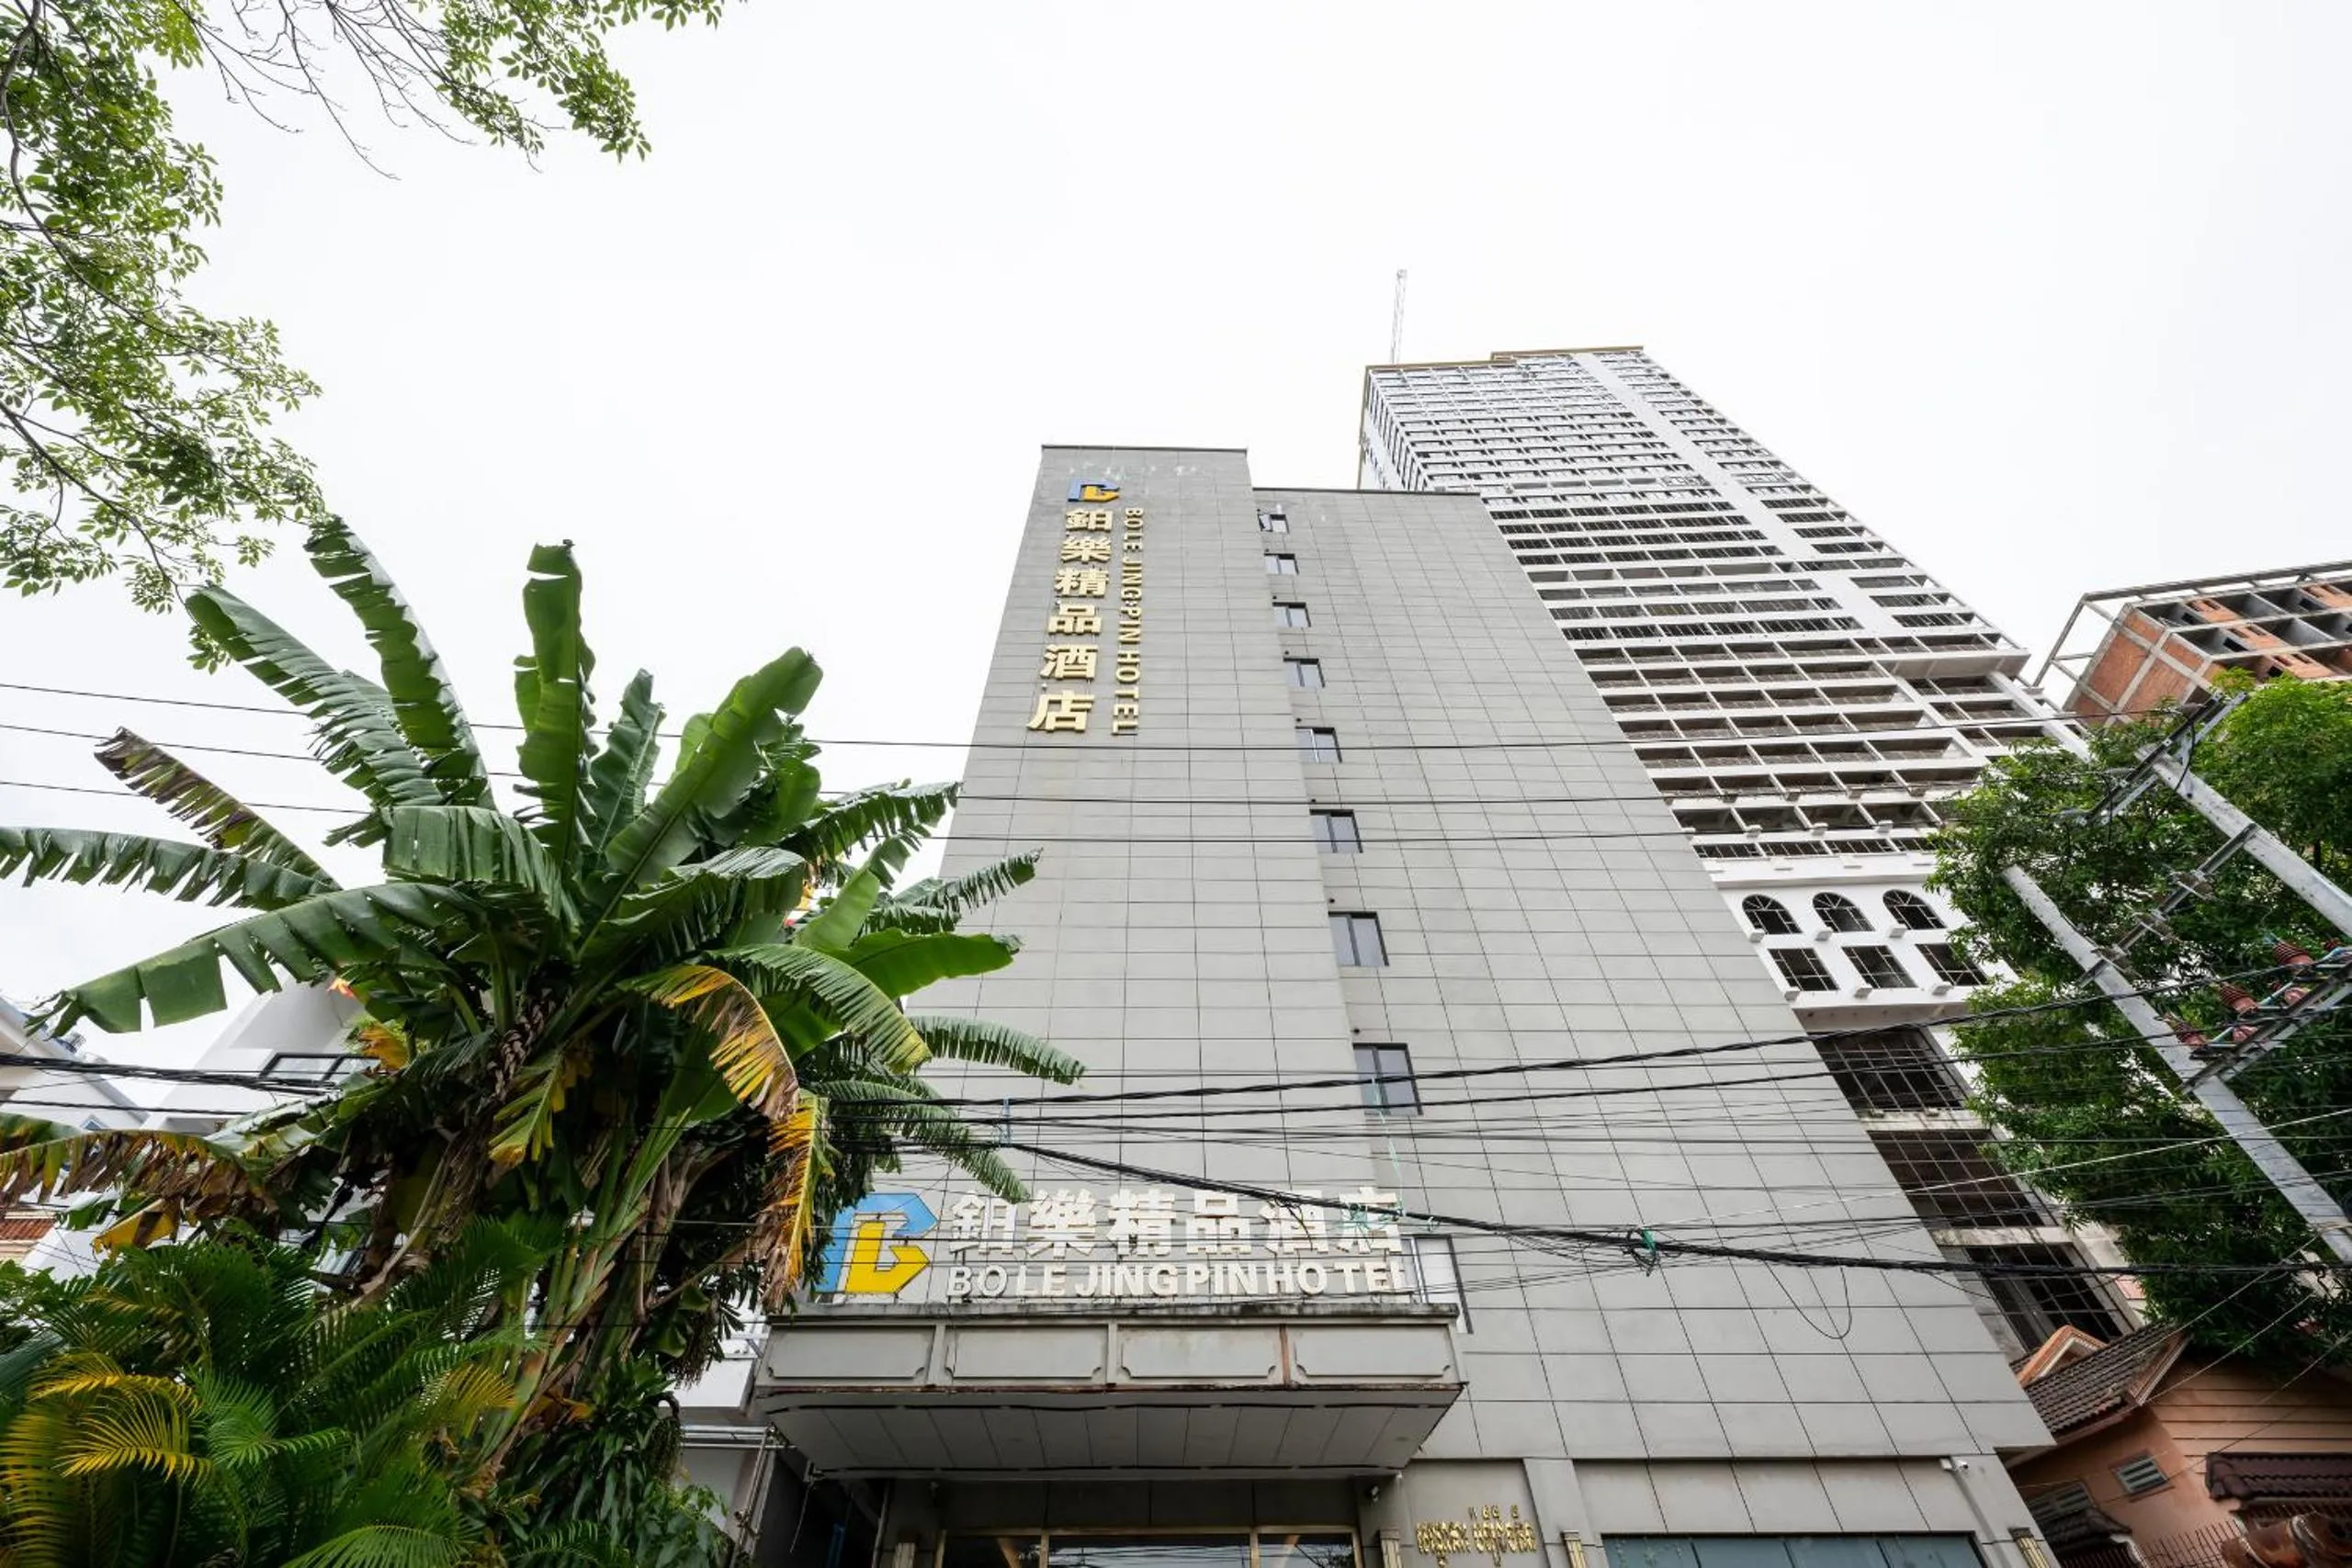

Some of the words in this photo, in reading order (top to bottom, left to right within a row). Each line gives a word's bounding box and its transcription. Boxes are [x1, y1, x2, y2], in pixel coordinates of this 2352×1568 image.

[1124, 508, 1144, 552] BOLE
[1026, 508, 1113, 732] 鉑樂精品酒店
[1118, 557, 1142, 644] JINGPIN
[1113, 651, 1141, 735] HOTEL
[946, 1264, 1066, 1298] BOLE
[1266, 1262, 1416, 1296] HOTEL
